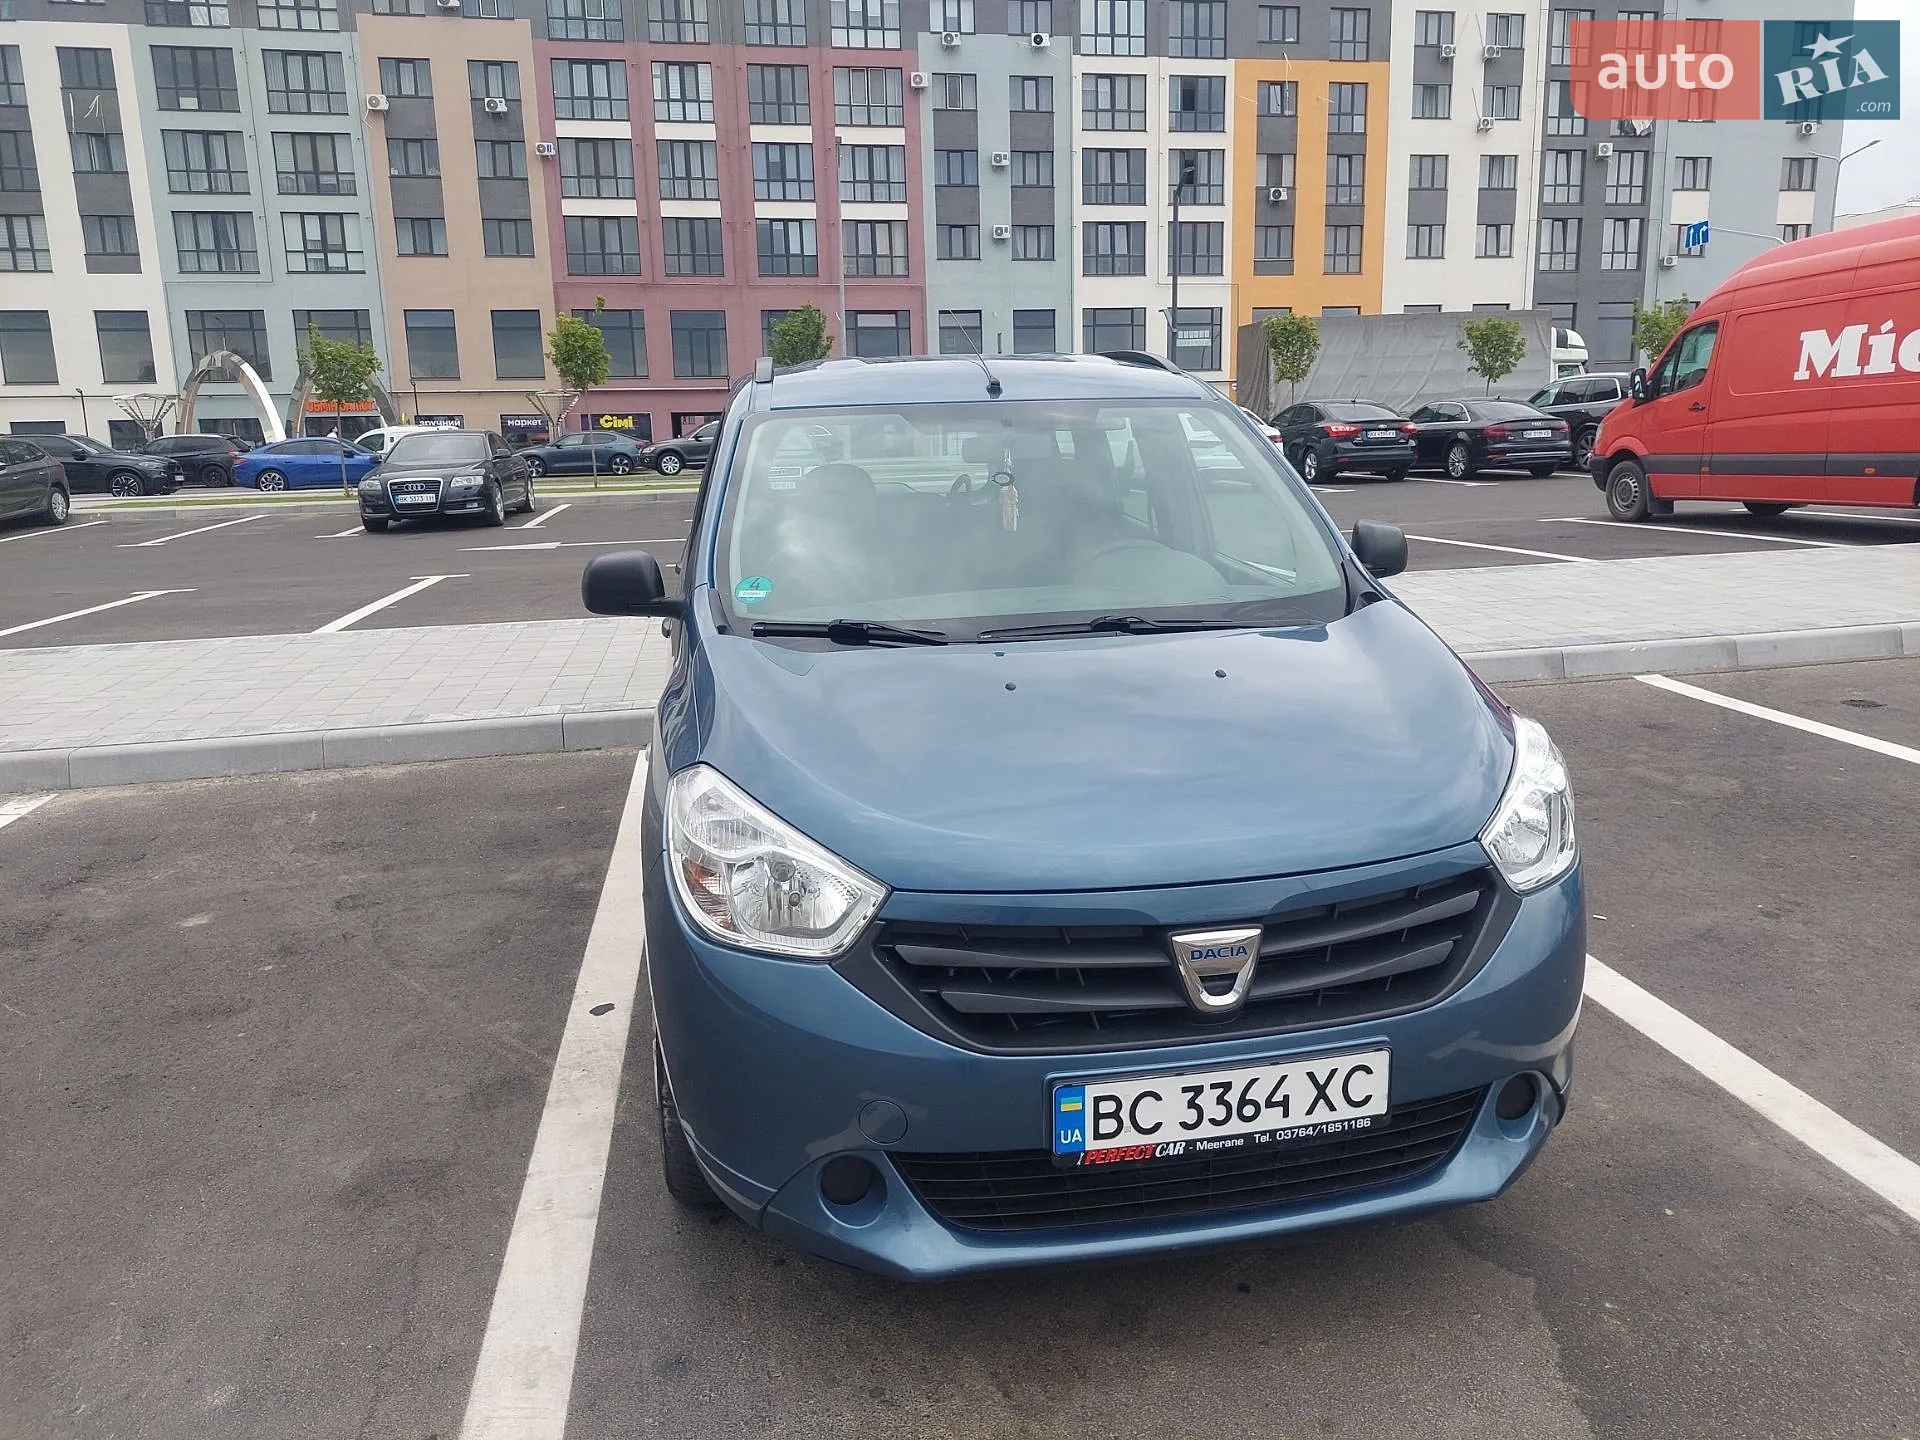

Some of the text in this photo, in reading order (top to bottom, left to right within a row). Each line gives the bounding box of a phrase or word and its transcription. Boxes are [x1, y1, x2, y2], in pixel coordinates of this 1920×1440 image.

[507, 418, 542, 428] маркет
[600, 414, 634, 429] Сімі
[750, 577, 761, 591] 4
[1190, 944, 1249, 961] DACIA
[1092, 1063, 1375, 1142] BC 3364 XC
[1060, 1127, 1083, 1144] UA
[1196, 1137, 1244, 1151] Meerane
[1253, 1131, 1273, 1144] Tel.
[1276, 1117, 1372, 1141] 03764/1851186
